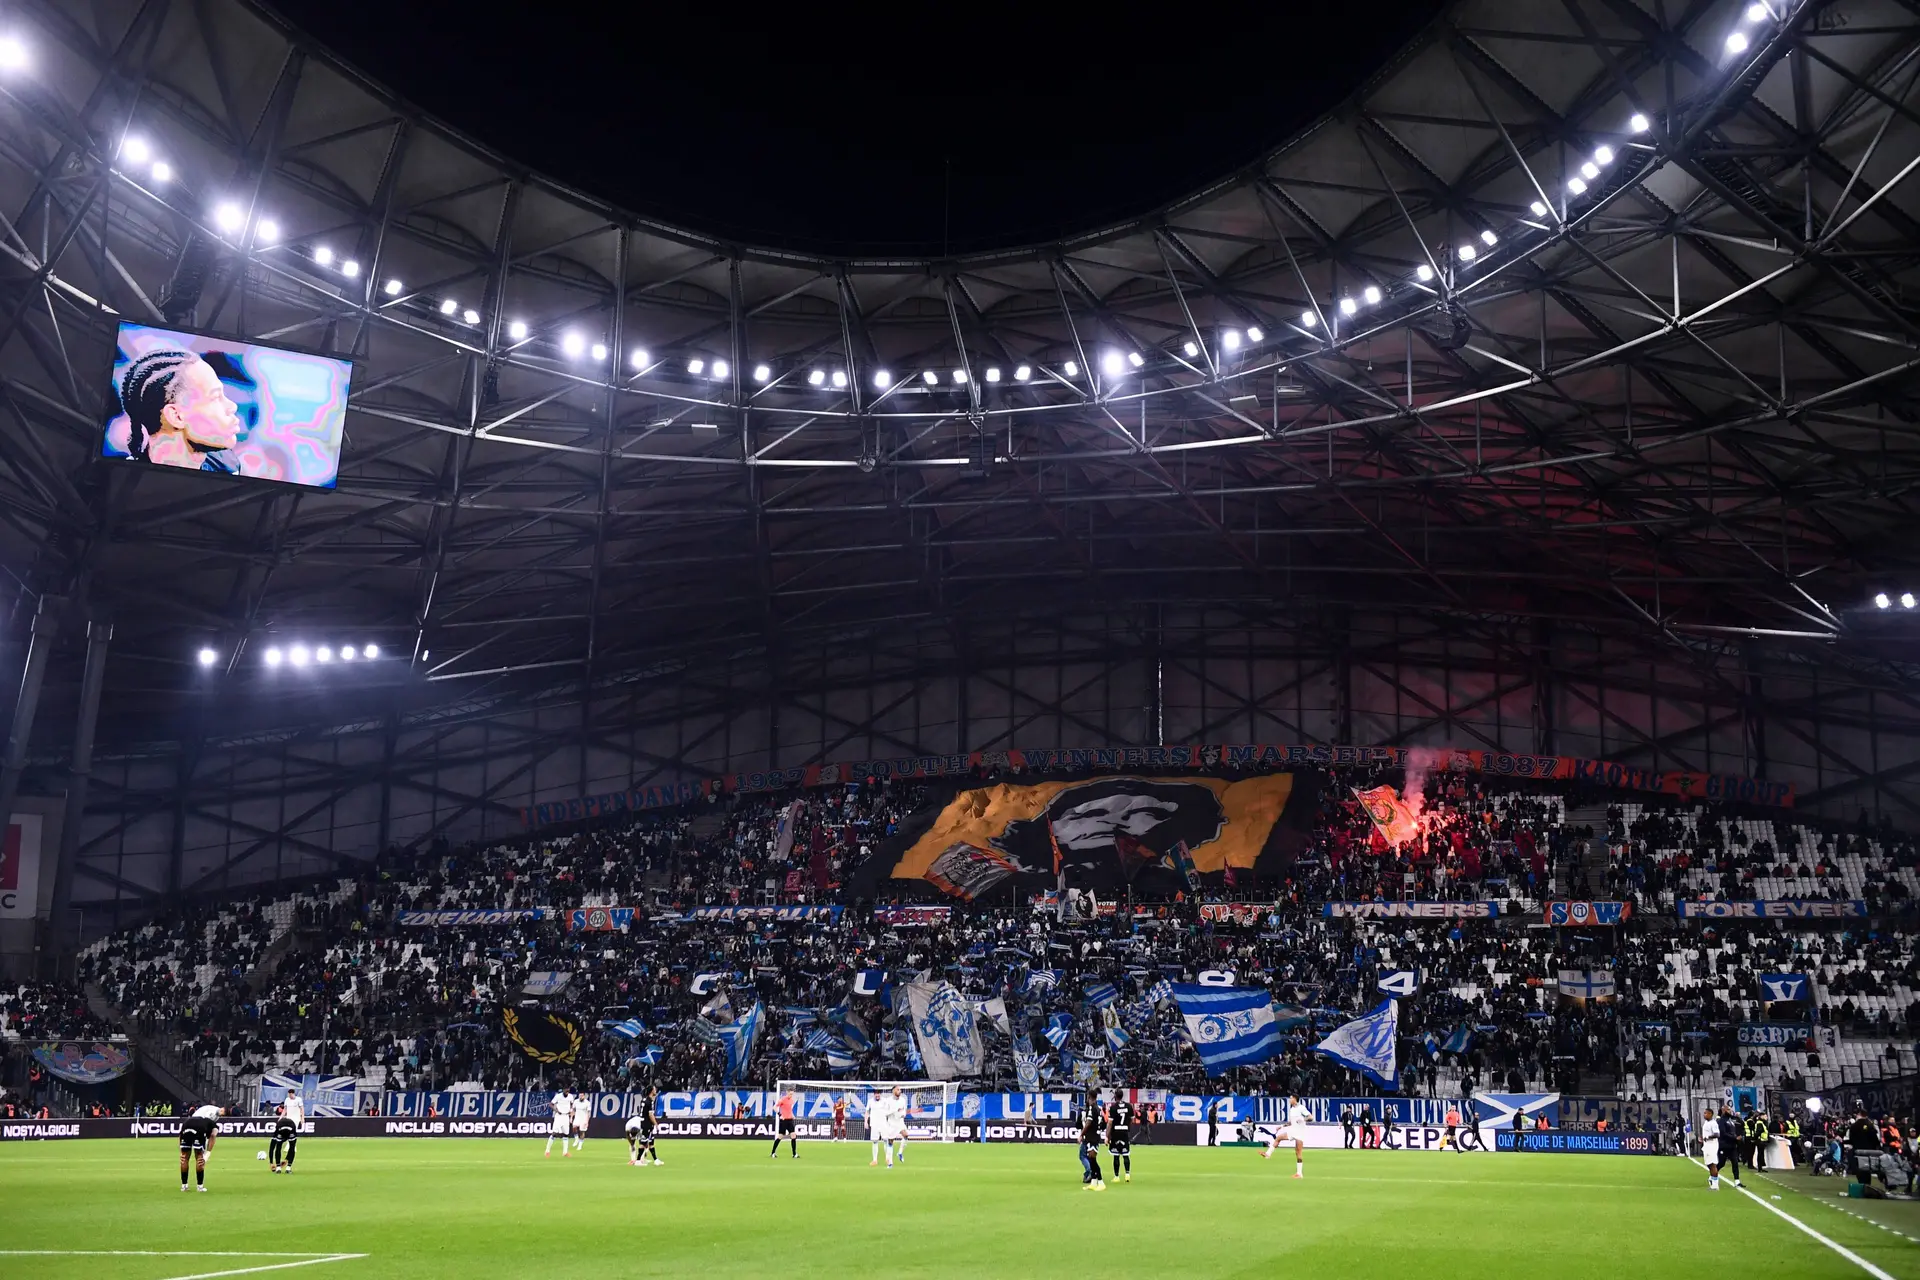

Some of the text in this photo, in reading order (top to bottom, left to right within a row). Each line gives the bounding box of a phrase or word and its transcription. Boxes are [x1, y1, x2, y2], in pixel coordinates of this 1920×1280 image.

[851, 745, 1559, 781] SOUTH WINNERS MARSEILL 1987
[1574, 758, 1790, 805] KAOTIC GROUP
[523, 766, 808, 826] INDEPENDANCE 1987
[0, 893, 16, 909] C
[1331, 902, 1490, 918] WINNERS
[1685, 902, 1860, 917] FOR EVER
[1378, 971, 1418, 996] 4
[297, 1090, 345, 1105] ARSEILLE
[663, 1091, 942, 1118] COMMANO
[1171, 1095, 1238, 1122] 84
[1258, 1097, 1330, 1122] LIBTE
[1558, 1100, 1680, 1123] ULTRAS
[1119, 1113, 1126, 1125] 7
[3, 1124, 80, 1137] NOSTALGIQUE
[130, 1122, 183, 1134] INCLU
[215, 1122, 315, 1135] OSTALGUE
[385, 1122, 555, 1134] INCLUS NOSTALGIQU
[652, 1123, 831, 1136] CLUS NOSTALQUE
[1552, 1135, 1565, 1148] DE
[1567, 1136, 1619, 1149] MARSEILLE
